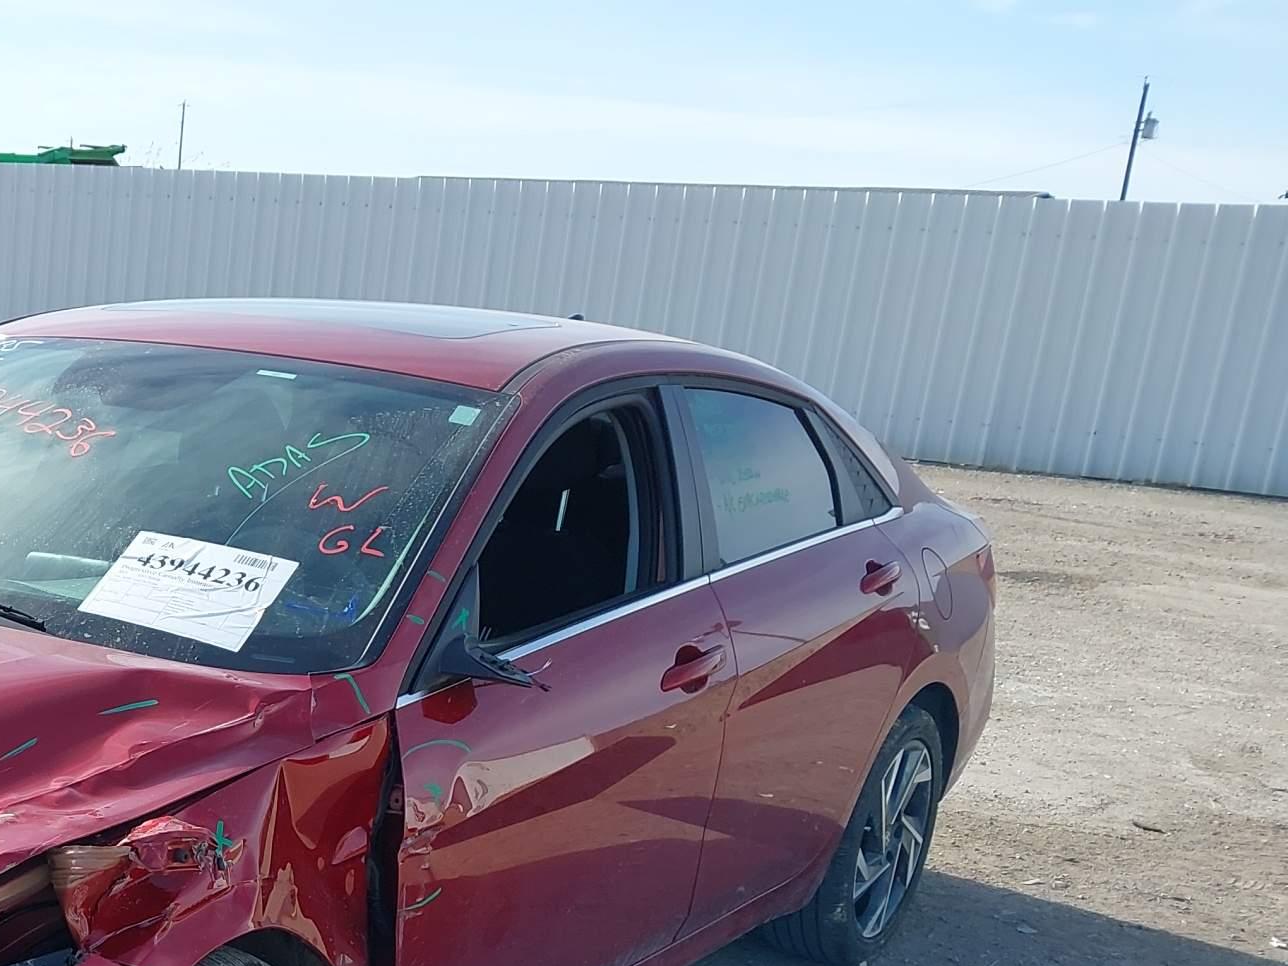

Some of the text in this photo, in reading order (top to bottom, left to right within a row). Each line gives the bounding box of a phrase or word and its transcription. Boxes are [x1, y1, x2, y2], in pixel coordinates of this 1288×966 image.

[227, 432, 371, 502] ADAS
[309, 481, 390, 513] W
[137, 553, 261, 593] 43944236
